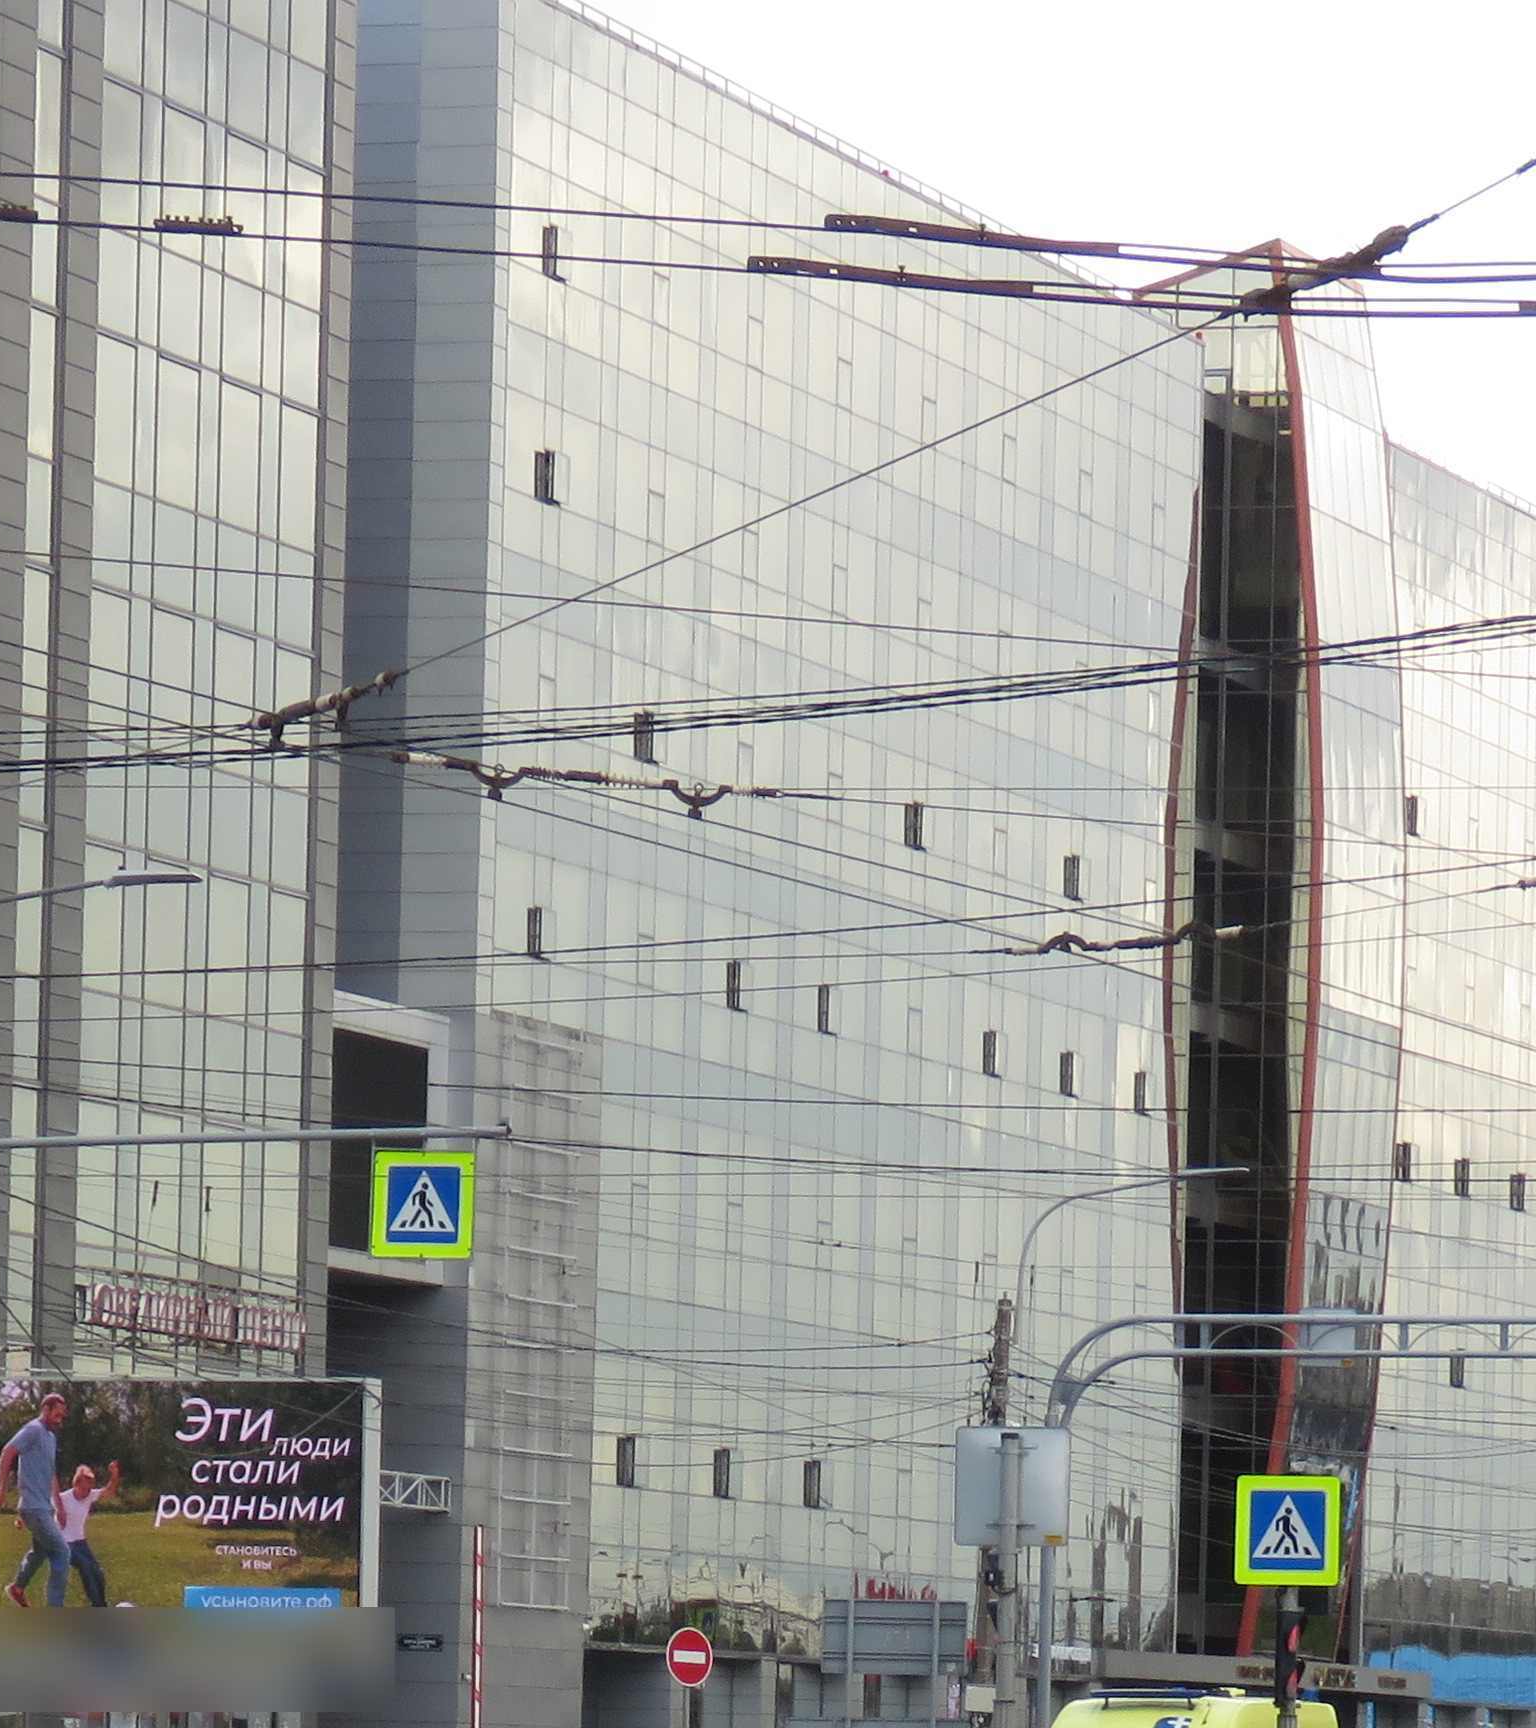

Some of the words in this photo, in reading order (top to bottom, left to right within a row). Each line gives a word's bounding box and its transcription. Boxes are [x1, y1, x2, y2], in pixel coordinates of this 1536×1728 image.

[174, 1397, 275, 1443] Эти
[268, 1436, 352, 1461] люди
[191, 1459, 301, 1485] стали
[154, 1494, 345, 1528] родными
[215, 1544, 298, 1557] СТАНОВИТЕСЬ
[241, 1559, 252, 1570] И
[253, 1560, 273, 1570] ВЫ
